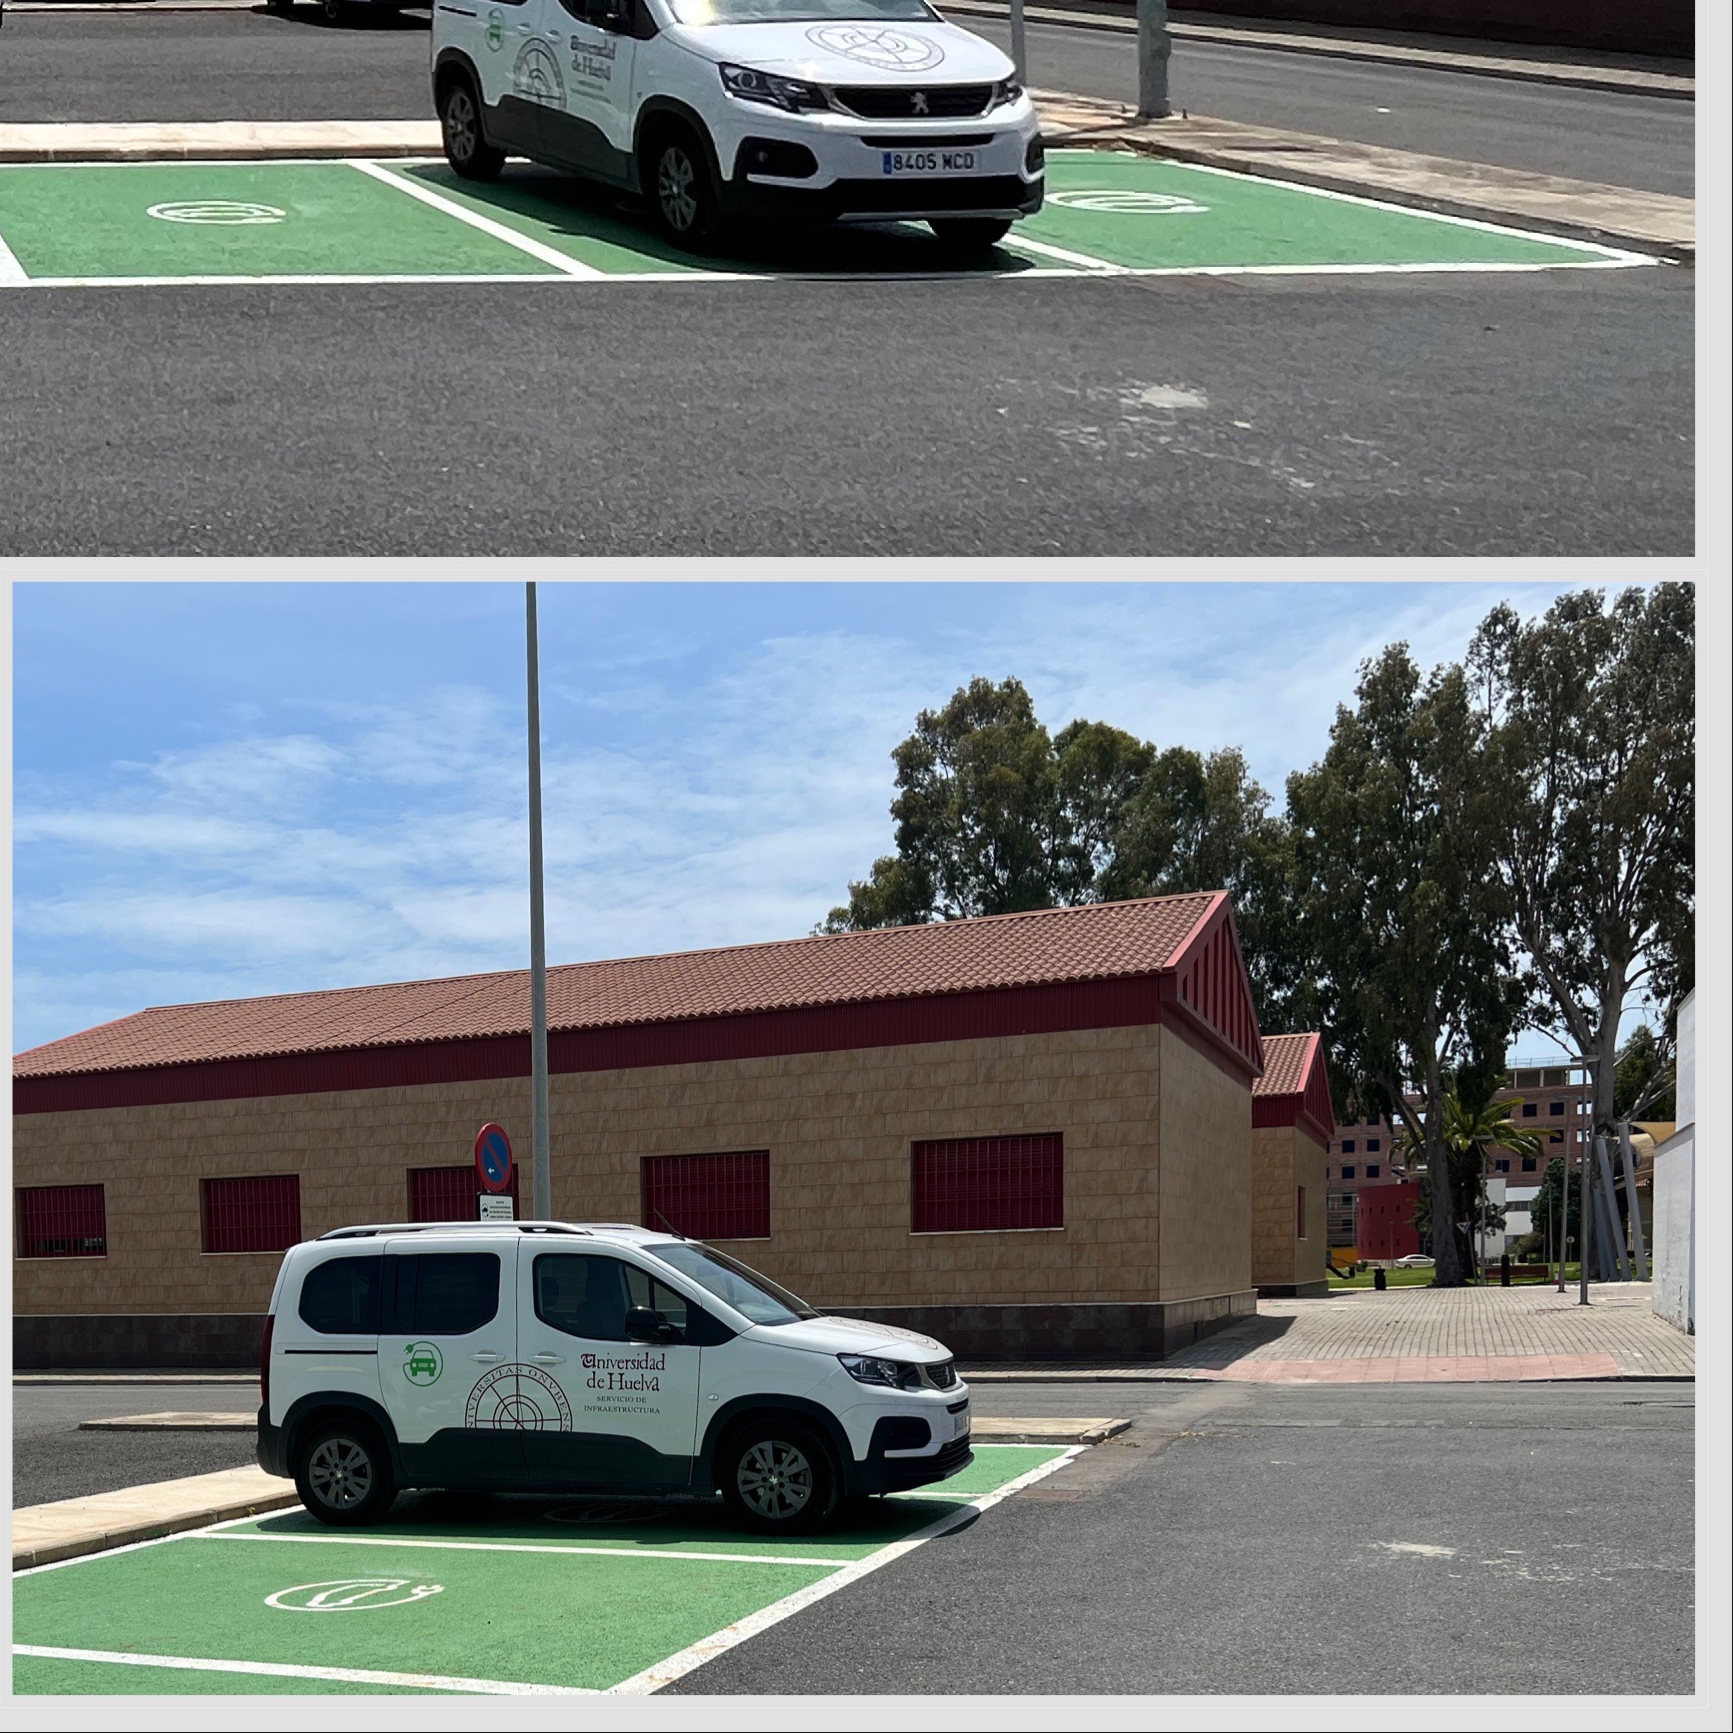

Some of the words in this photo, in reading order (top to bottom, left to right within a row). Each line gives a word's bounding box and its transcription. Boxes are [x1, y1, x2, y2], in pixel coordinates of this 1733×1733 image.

[893, 153, 937, 170] 8405
[580, 1352, 666, 1371] Universidad
[586, 1371, 605, 1389] de
[607, 1372, 660, 1392] Huelva
[596, 1395, 634, 1403] SERVICIO
[635, 1396, 647, 1404] DE
[584, 1405, 660, 1414] INFRAESTRUCTURA
